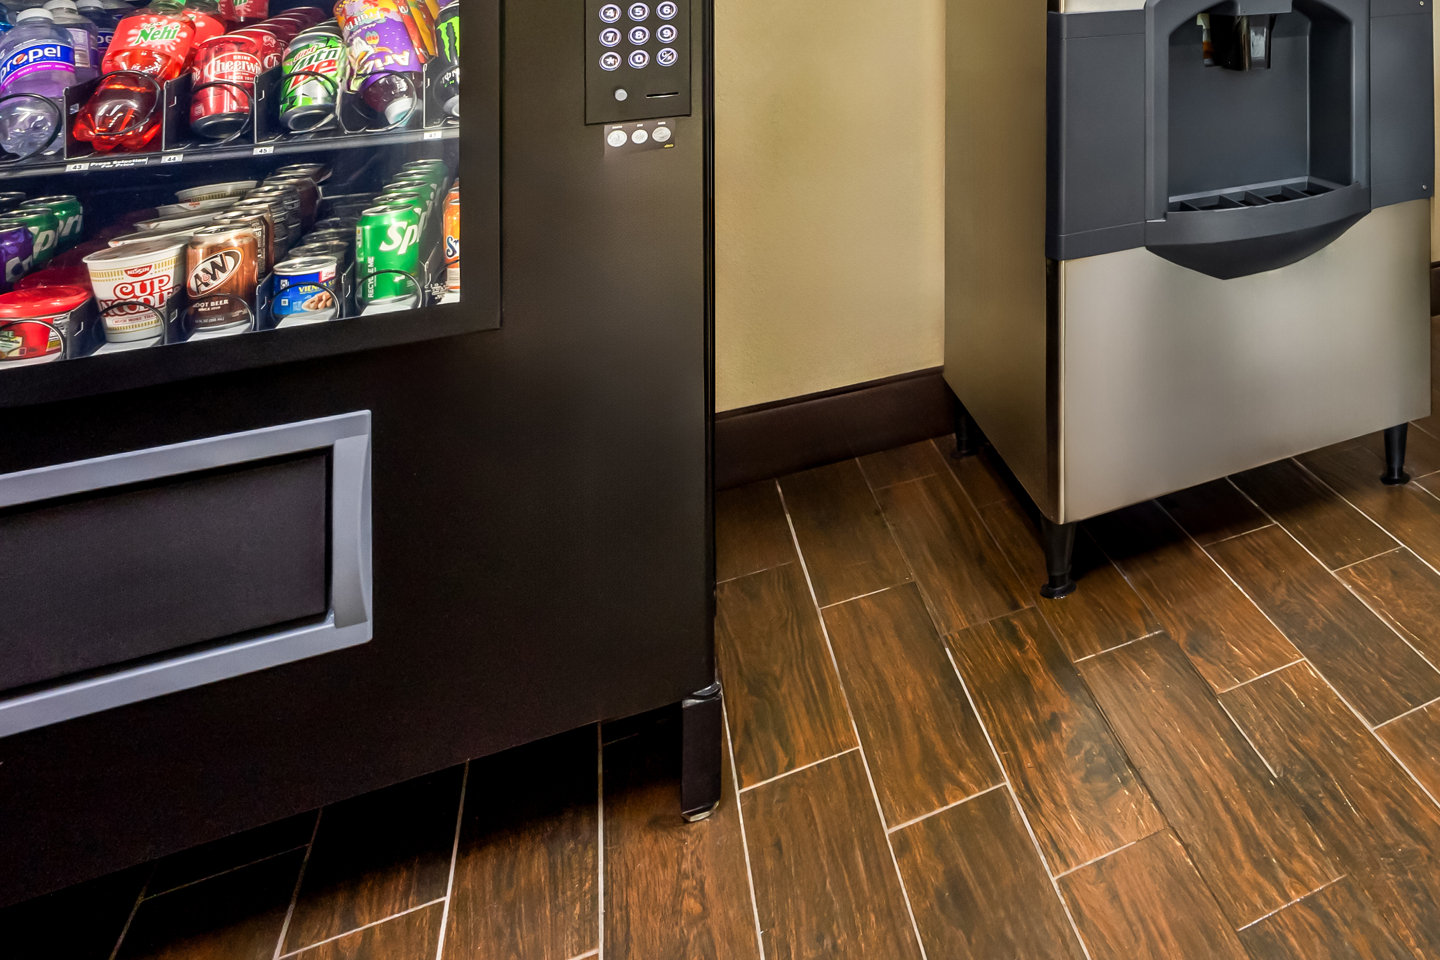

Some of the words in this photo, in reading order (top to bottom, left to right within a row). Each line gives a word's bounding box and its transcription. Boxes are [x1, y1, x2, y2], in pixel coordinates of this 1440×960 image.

[135, 25, 180, 45] Nehi
[127, 267, 151, 276] NISSIN
[194, 253, 229, 294] A&W
[114, 275, 170, 300] CUP
[210, 299, 229, 307] BEER
